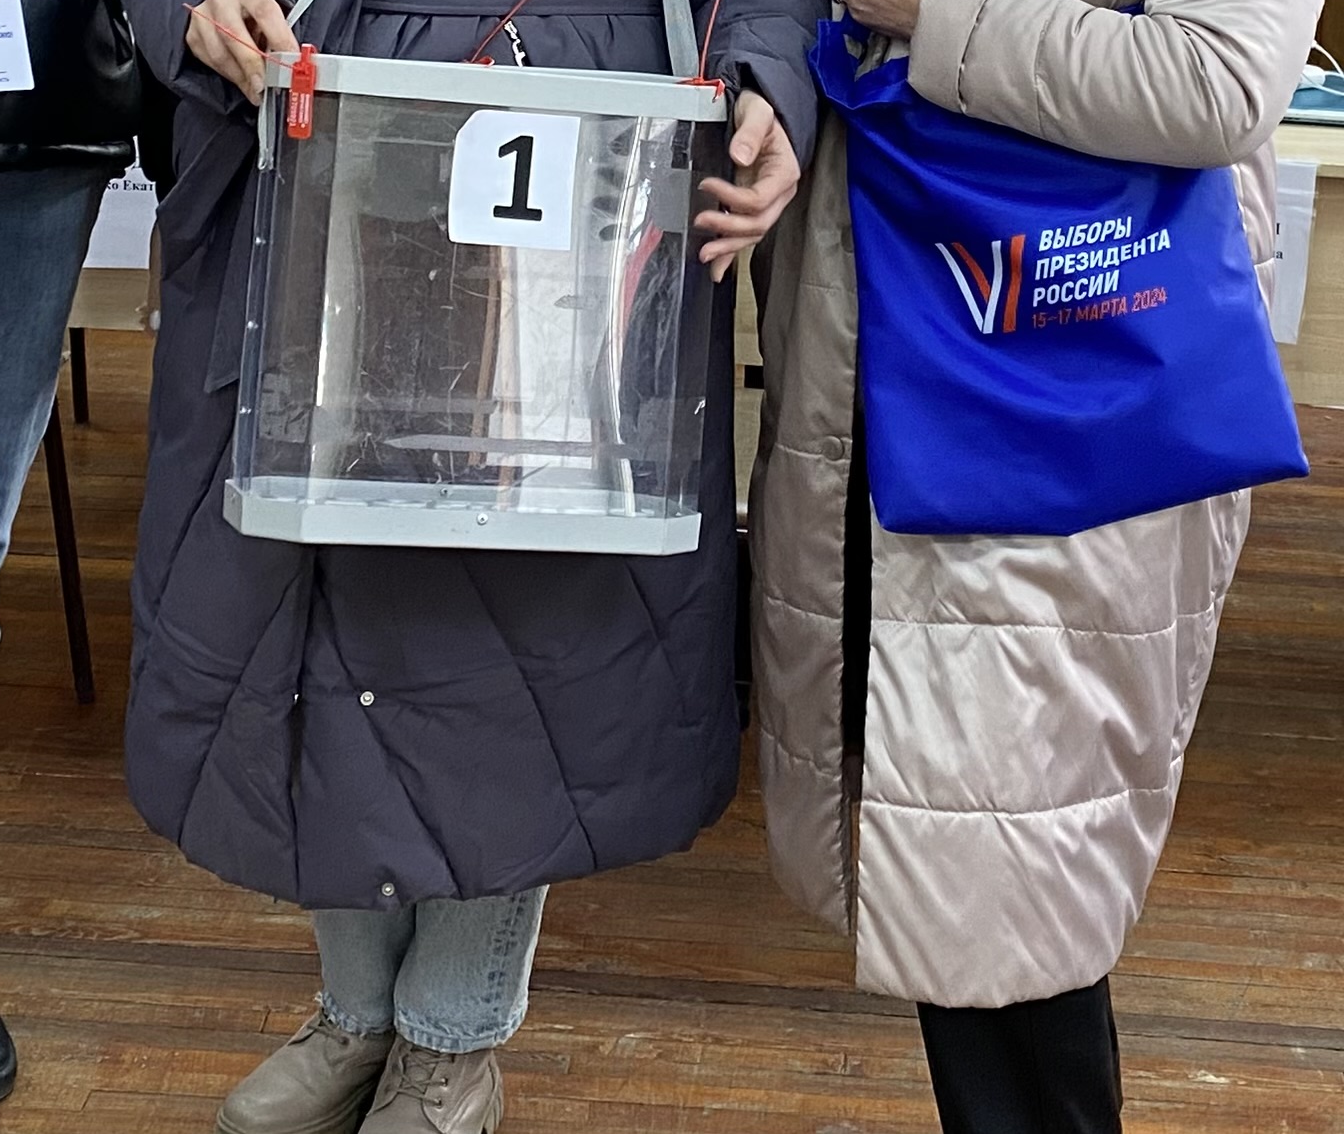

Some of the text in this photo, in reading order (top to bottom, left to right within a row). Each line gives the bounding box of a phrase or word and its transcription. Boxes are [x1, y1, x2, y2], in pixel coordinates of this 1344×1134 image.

[493, 135, 543, 222] 1
[1038, 216, 1132, 252] ВЫБОРЫ
[1035, 229, 1171, 280] ПРЕЗИДЕНТА
[1033, 270, 1120, 307] РОССИИ
[1075, 296, 1127, 323] МАРТА
[1132, 286, 1168, 312] 2024
